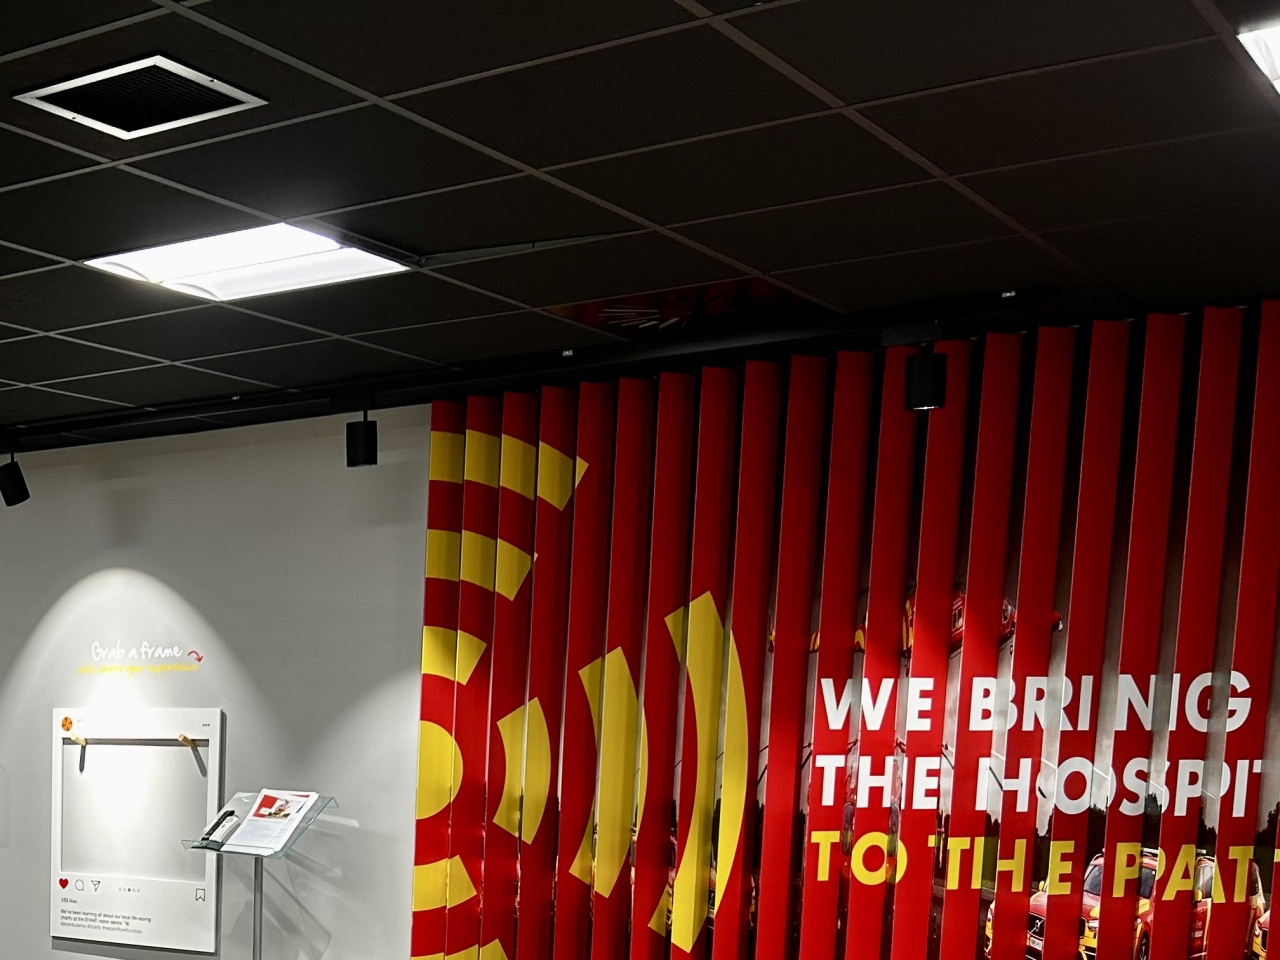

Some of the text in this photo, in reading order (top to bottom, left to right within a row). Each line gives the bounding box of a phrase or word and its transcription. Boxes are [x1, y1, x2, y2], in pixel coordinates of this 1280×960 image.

[91, 639, 183, 661] Grab a frame
[821, 677, 934, 731] WE
[815, 755, 940, 810] THE
[811, 830, 907, 886] TO
[928, 833, 1075, 895] THE
